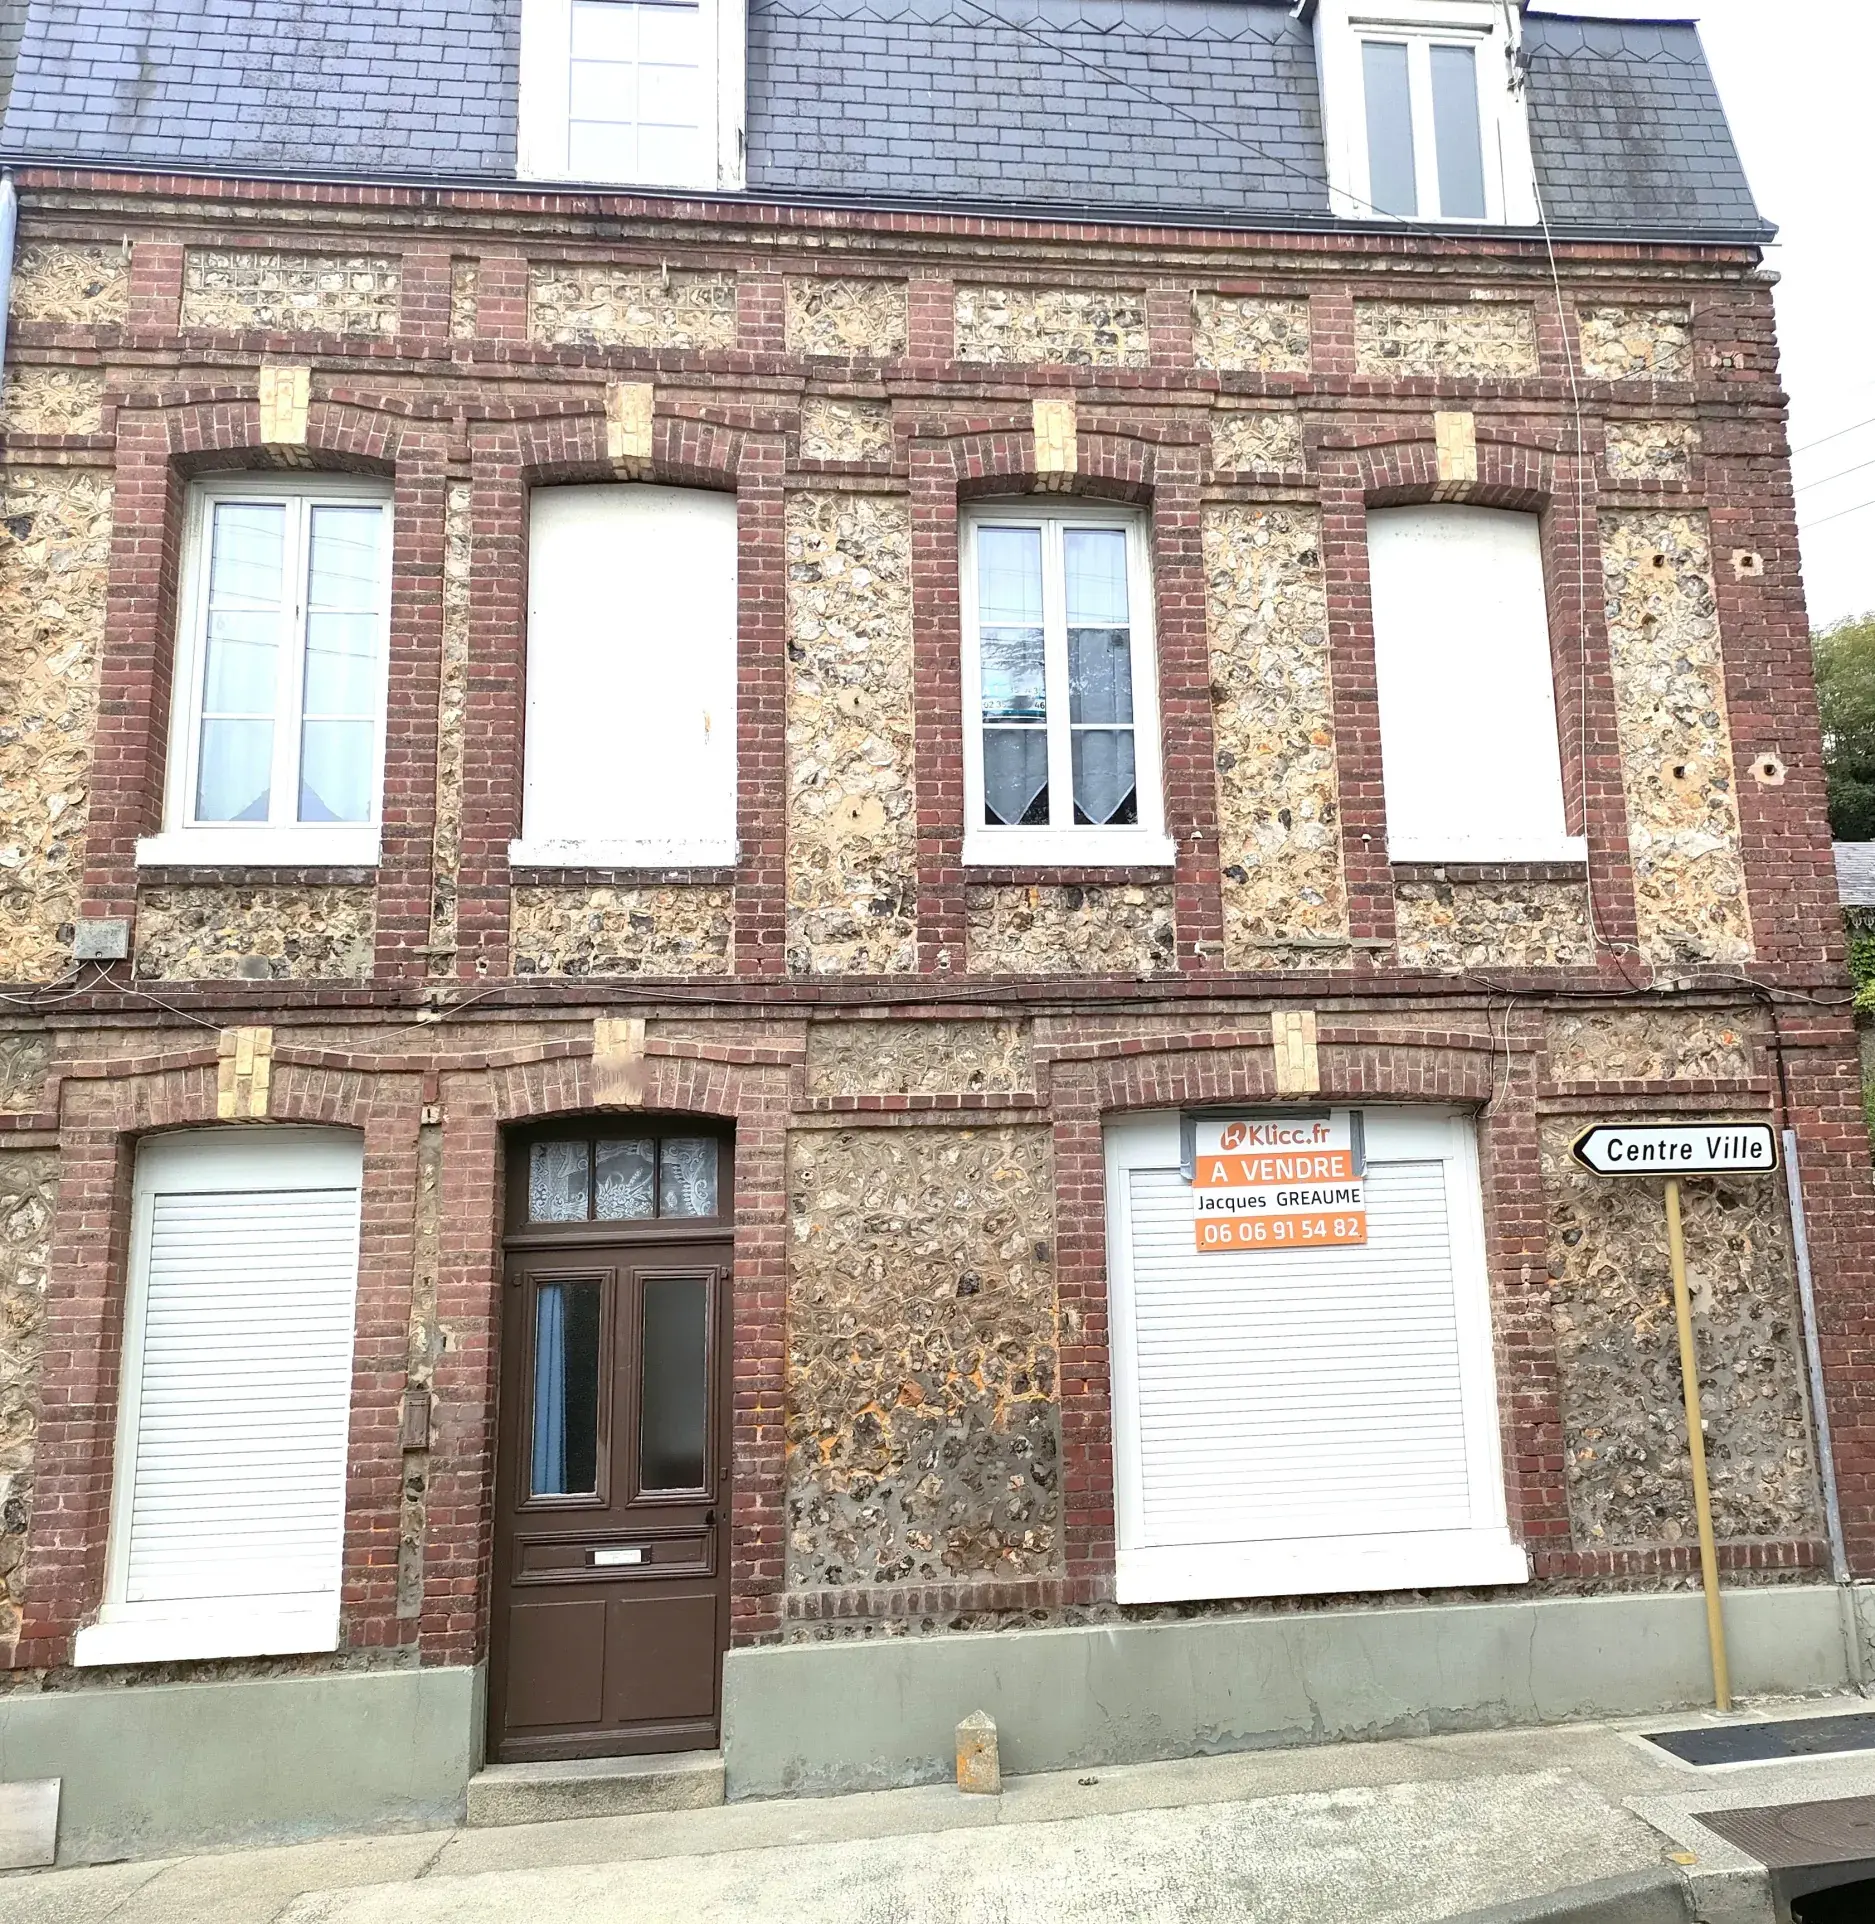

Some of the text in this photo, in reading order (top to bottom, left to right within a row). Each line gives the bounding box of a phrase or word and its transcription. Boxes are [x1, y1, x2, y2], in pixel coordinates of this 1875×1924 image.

[1249, 1123, 1331, 1147] Klicc.fr
[1607, 1135, 1763, 1162] Centre Ville
[1211, 1156, 1345, 1183] A VENDRE
[1198, 1188, 1361, 1213] Jacques GREAUME
[1204, 1217, 1360, 1244] 06 06 91 54 82
